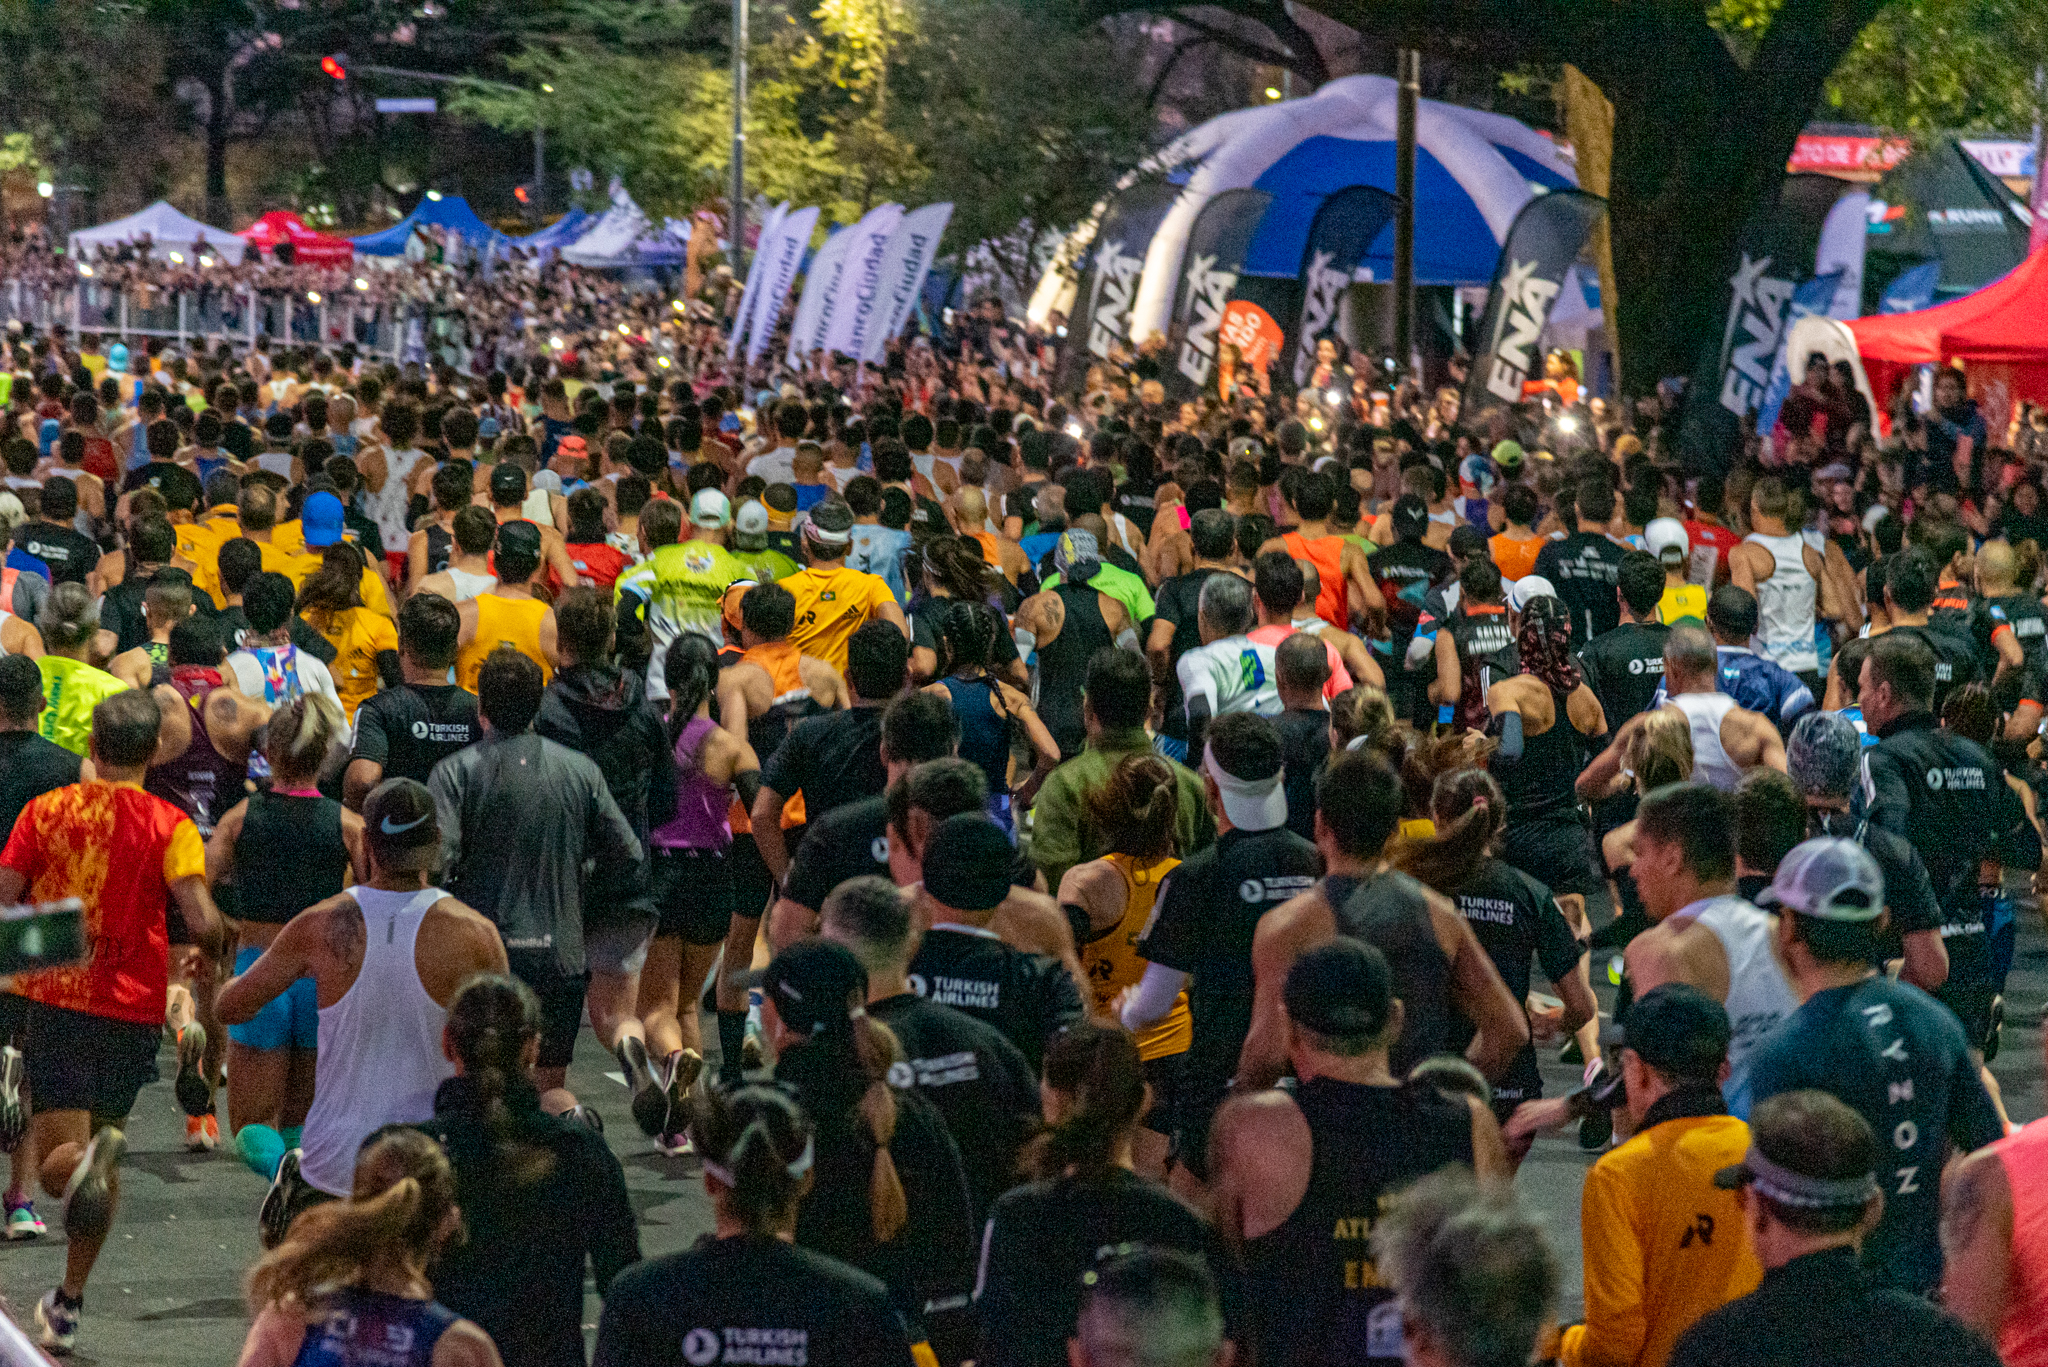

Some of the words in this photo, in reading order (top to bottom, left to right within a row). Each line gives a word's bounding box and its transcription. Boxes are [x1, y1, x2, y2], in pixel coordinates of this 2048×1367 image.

[1178, 268, 1238, 387] ENA
[1487, 276, 1559, 403] ENA
[428, 723, 470, 733] TURKISH
[428, 732, 470, 742] AIRLINES
[1459, 895, 1514, 914] TURKISH
[1459, 907, 1514, 926] AIRLINES
[933, 975, 1000, 995] TURKISH
[932, 990, 999, 1009] AIRLINES
